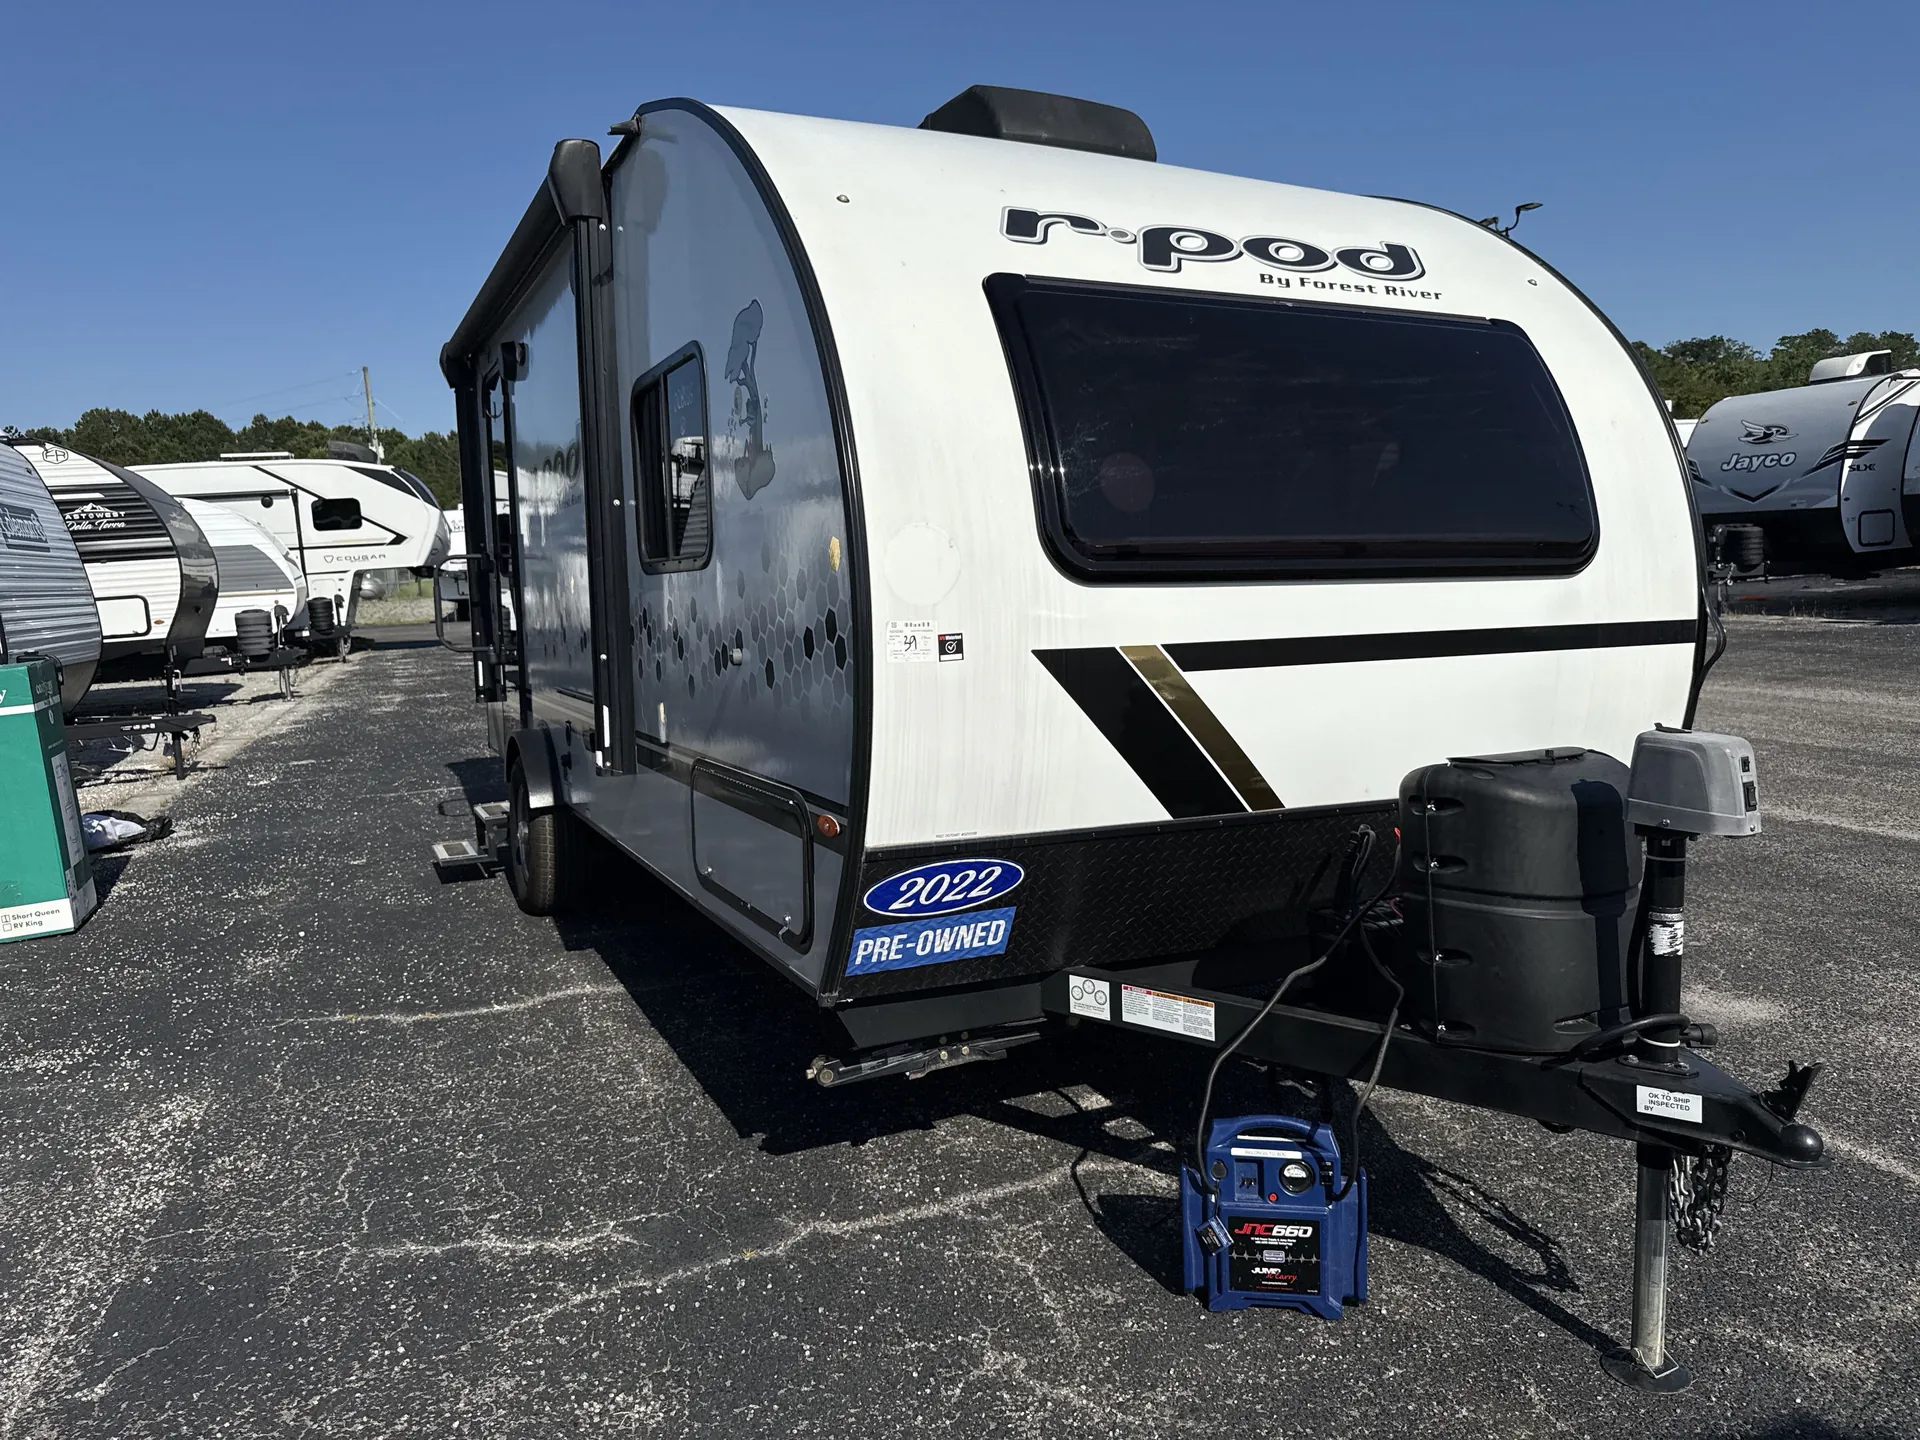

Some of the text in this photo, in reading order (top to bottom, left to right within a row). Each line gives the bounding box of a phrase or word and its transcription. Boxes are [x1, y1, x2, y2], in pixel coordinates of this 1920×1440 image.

[1259, 273, 1443, 300] By Forest River
[1721, 452, 1797, 473] Jayco
[66, 518, 126, 531] Della Terra
[336, 554, 386, 562] COUGAR
[888, 866, 1002, 911] 2022
[11, 909, 60, 921] Short Queen
[855, 920, 1006, 965] PRE-OWNED
[1648, 1099, 1691, 1111] INSPECTED
[1673, 1096, 1691, 1104] SHIP
[1234, 1223, 1313, 1238] JNC660
[1251, 1267, 1281, 1275] JUMP
